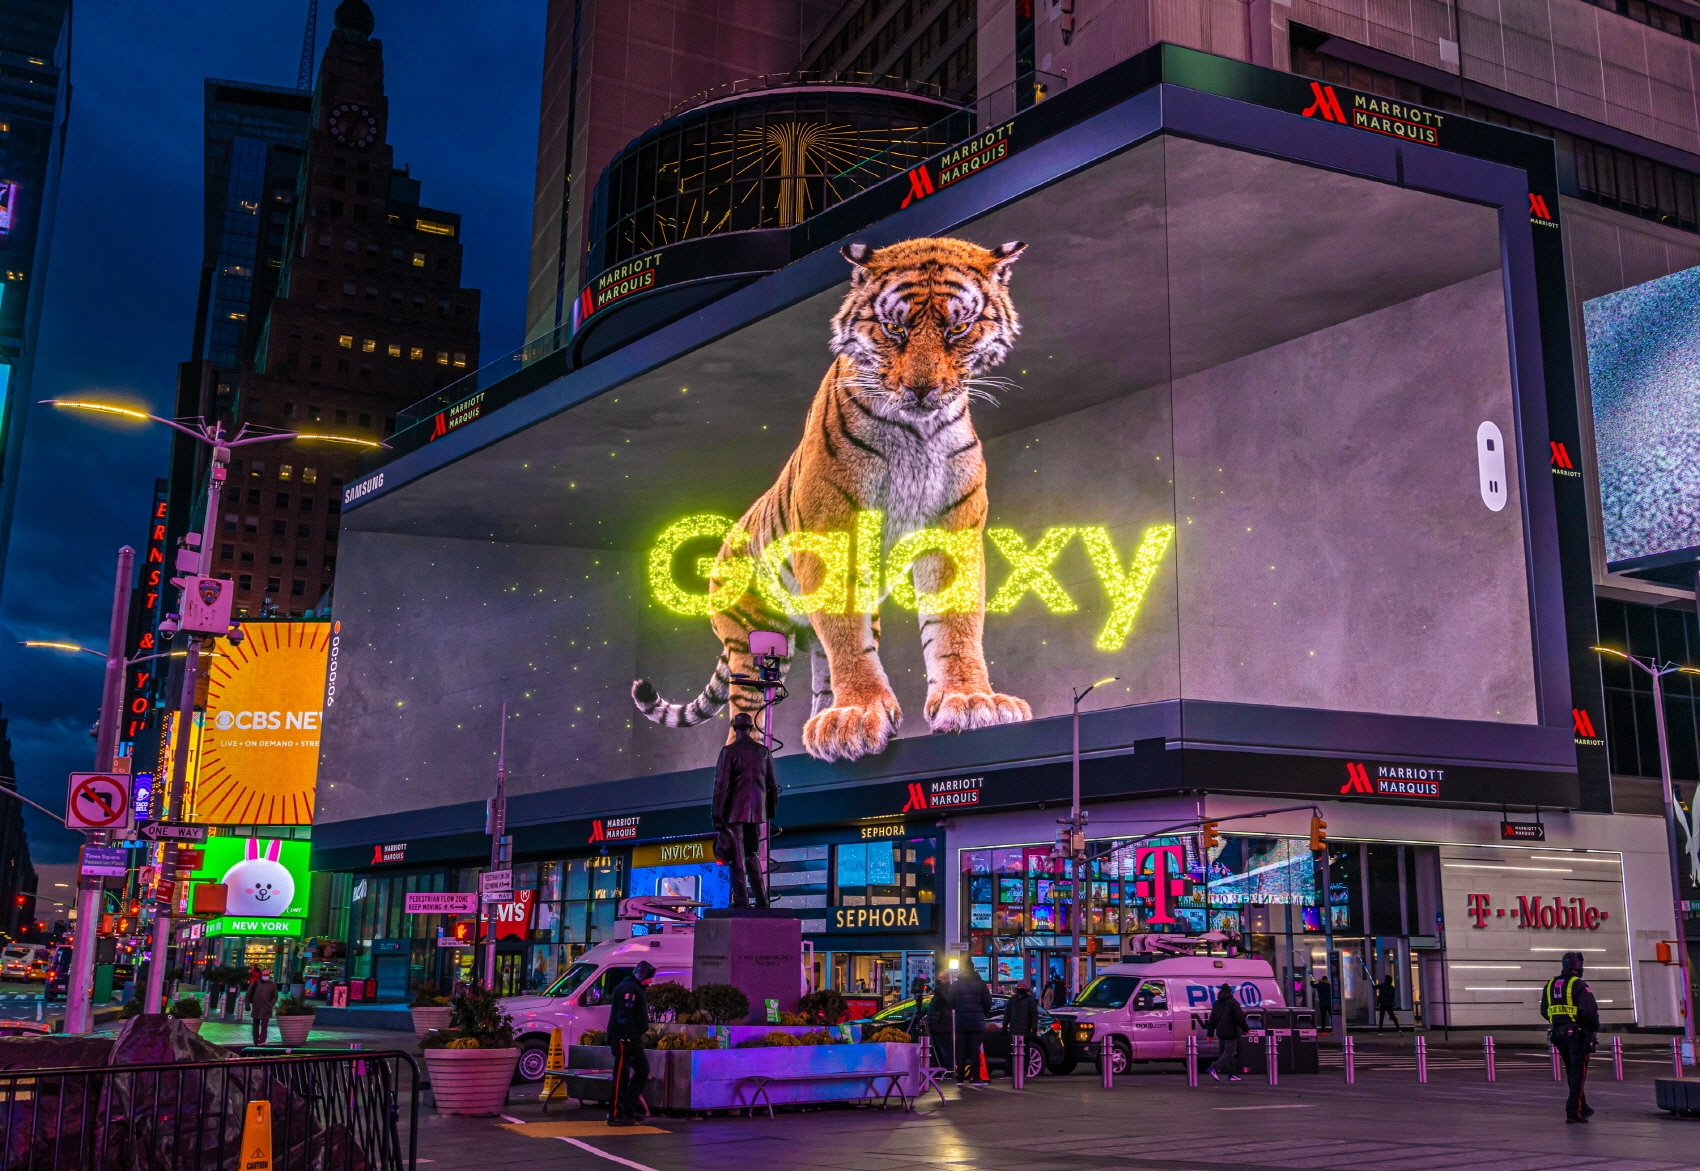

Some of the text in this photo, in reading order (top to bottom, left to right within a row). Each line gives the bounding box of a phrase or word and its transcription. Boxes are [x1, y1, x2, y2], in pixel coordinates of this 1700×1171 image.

[1355, 95, 1444, 128] MARRIOTT
[1356, 112, 1435, 142] MARQUIS
[941, 121, 1015, 169] MARRIOTT
[941, 143, 1005, 186] MARQUIS
[1530, 218, 1559, 228] MARRIOTT
[599, 253, 662, 290] MARRIOTT
[598, 272, 652, 306] MARQUIS
[450, 392, 485, 417] MARRIOTT
[449, 406, 480, 429] MARQUIS
[1552, 468, 1581, 478] MARRIOTT
[344, 472, 384, 504] SAMSUNG
[146, 502, 168, 609] ERNST
[648, 510, 1175, 652] Galaxy
[235, 711, 322, 730] CBS NE
[1379, 766, 1444, 780] MARRIOTT
[931, 778, 984, 793] MARRIOTT
[1380, 781, 1438, 794] MARQUIS
[931, 792, 978, 806] MARQUIS
[607, 816, 640, 828] MARRIOTT
[148, 826, 200, 837] ONE WAY
[606, 828, 636, 838] MARQUIS
[861, 826, 906, 838] SEPHORA
[384, 844, 408, 852] MARRIOTT
[660, 844, 704, 862] INVICTA
[383, 852, 404, 861] MARQUIS
[836, 908, 920, 928] SEPHORA
[232, 921, 258, 930] NEW
[261, 922, 290, 932] YORK
[246, 1161, 268, 1170] CAUTION
